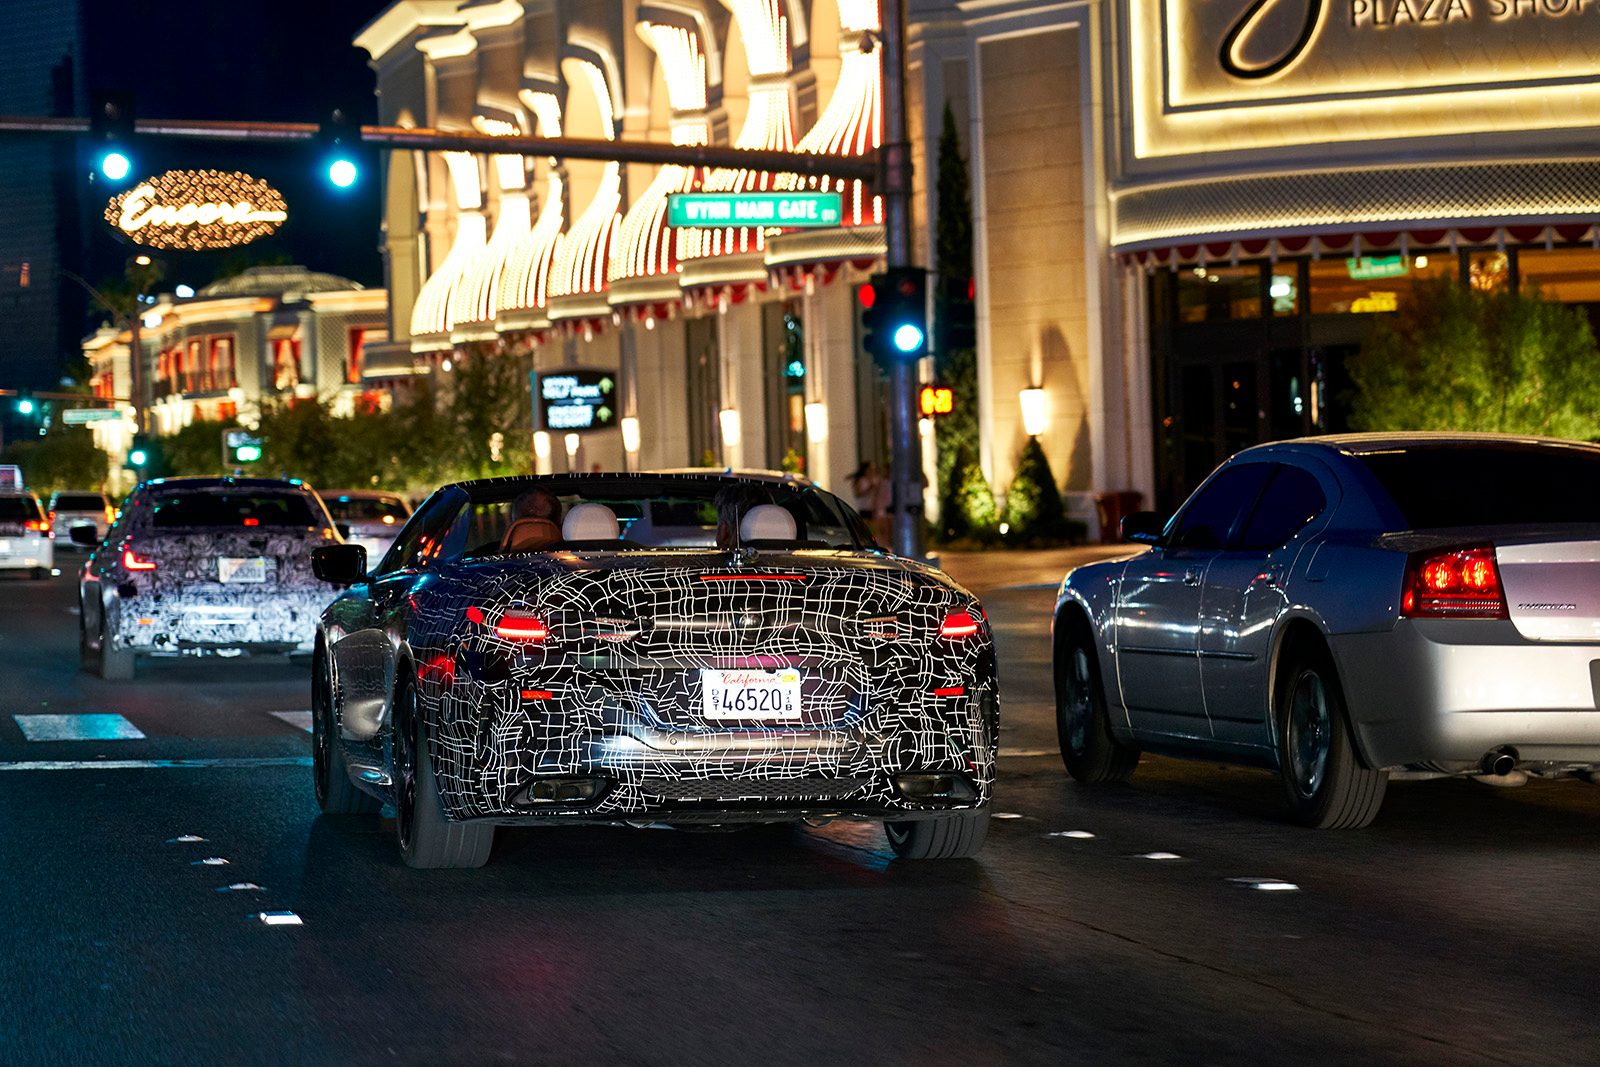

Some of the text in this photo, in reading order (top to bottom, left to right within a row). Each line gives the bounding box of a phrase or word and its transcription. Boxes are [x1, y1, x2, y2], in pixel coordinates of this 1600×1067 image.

[1351, 0, 1470, 28] PLAZA
[119, 185, 287, 232] Encore
[685, 201, 731, 220] WYNN
[735, 201, 775, 219] MAIN
[778, 200, 818, 220] GATE
[722, 673, 777, 687] California
[723, 688, 783, 712] 46520
